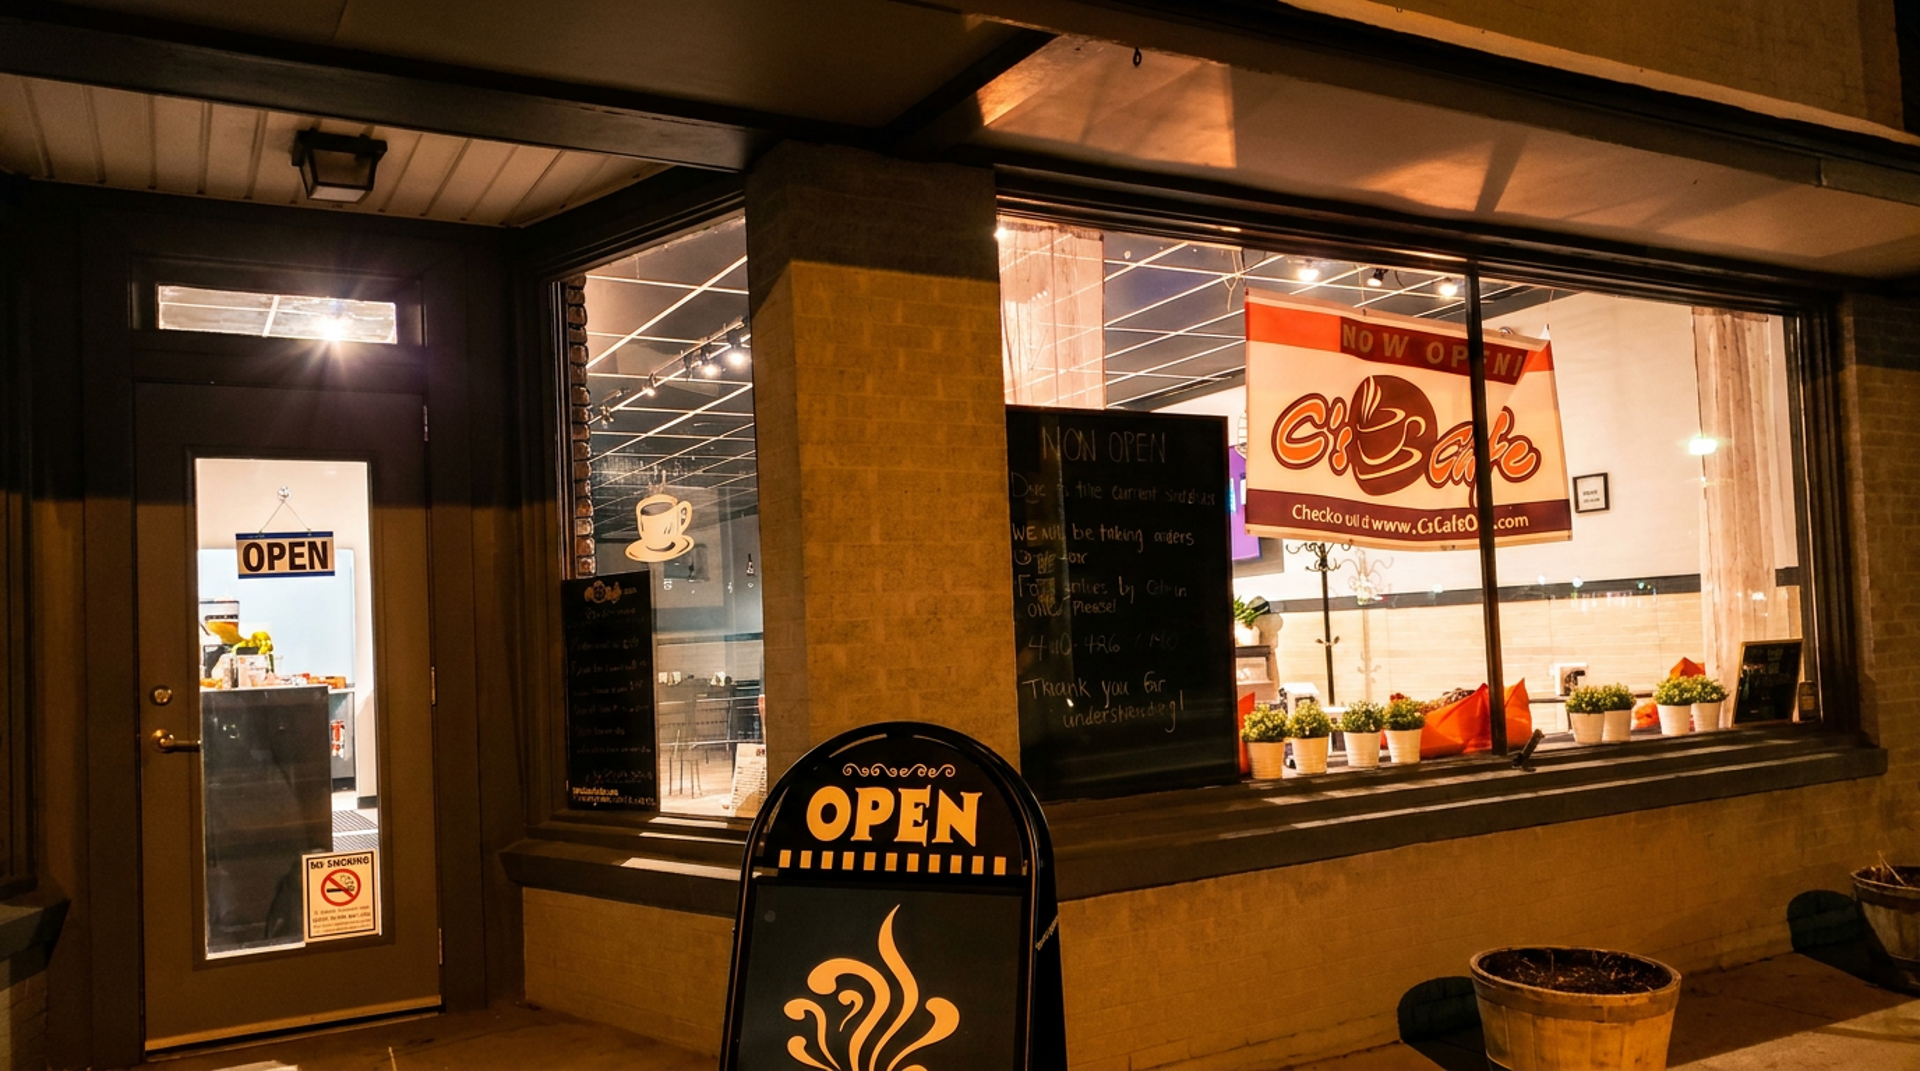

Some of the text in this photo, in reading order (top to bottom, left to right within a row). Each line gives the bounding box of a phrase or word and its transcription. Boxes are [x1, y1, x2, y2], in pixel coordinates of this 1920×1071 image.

[1342, 323, 1410, 359] NOW
[1109, 431, 1166, 464] OPEN
[1072, 523, 1094, 541] be
[1099, 524, 1144, 554] taking
[243, 540, 328, 572] OPEN
[1022, 677, 1091, 699] Thank
[1101, 679, 1129, 709] you
[805, 784, 983, 848] OPEN
